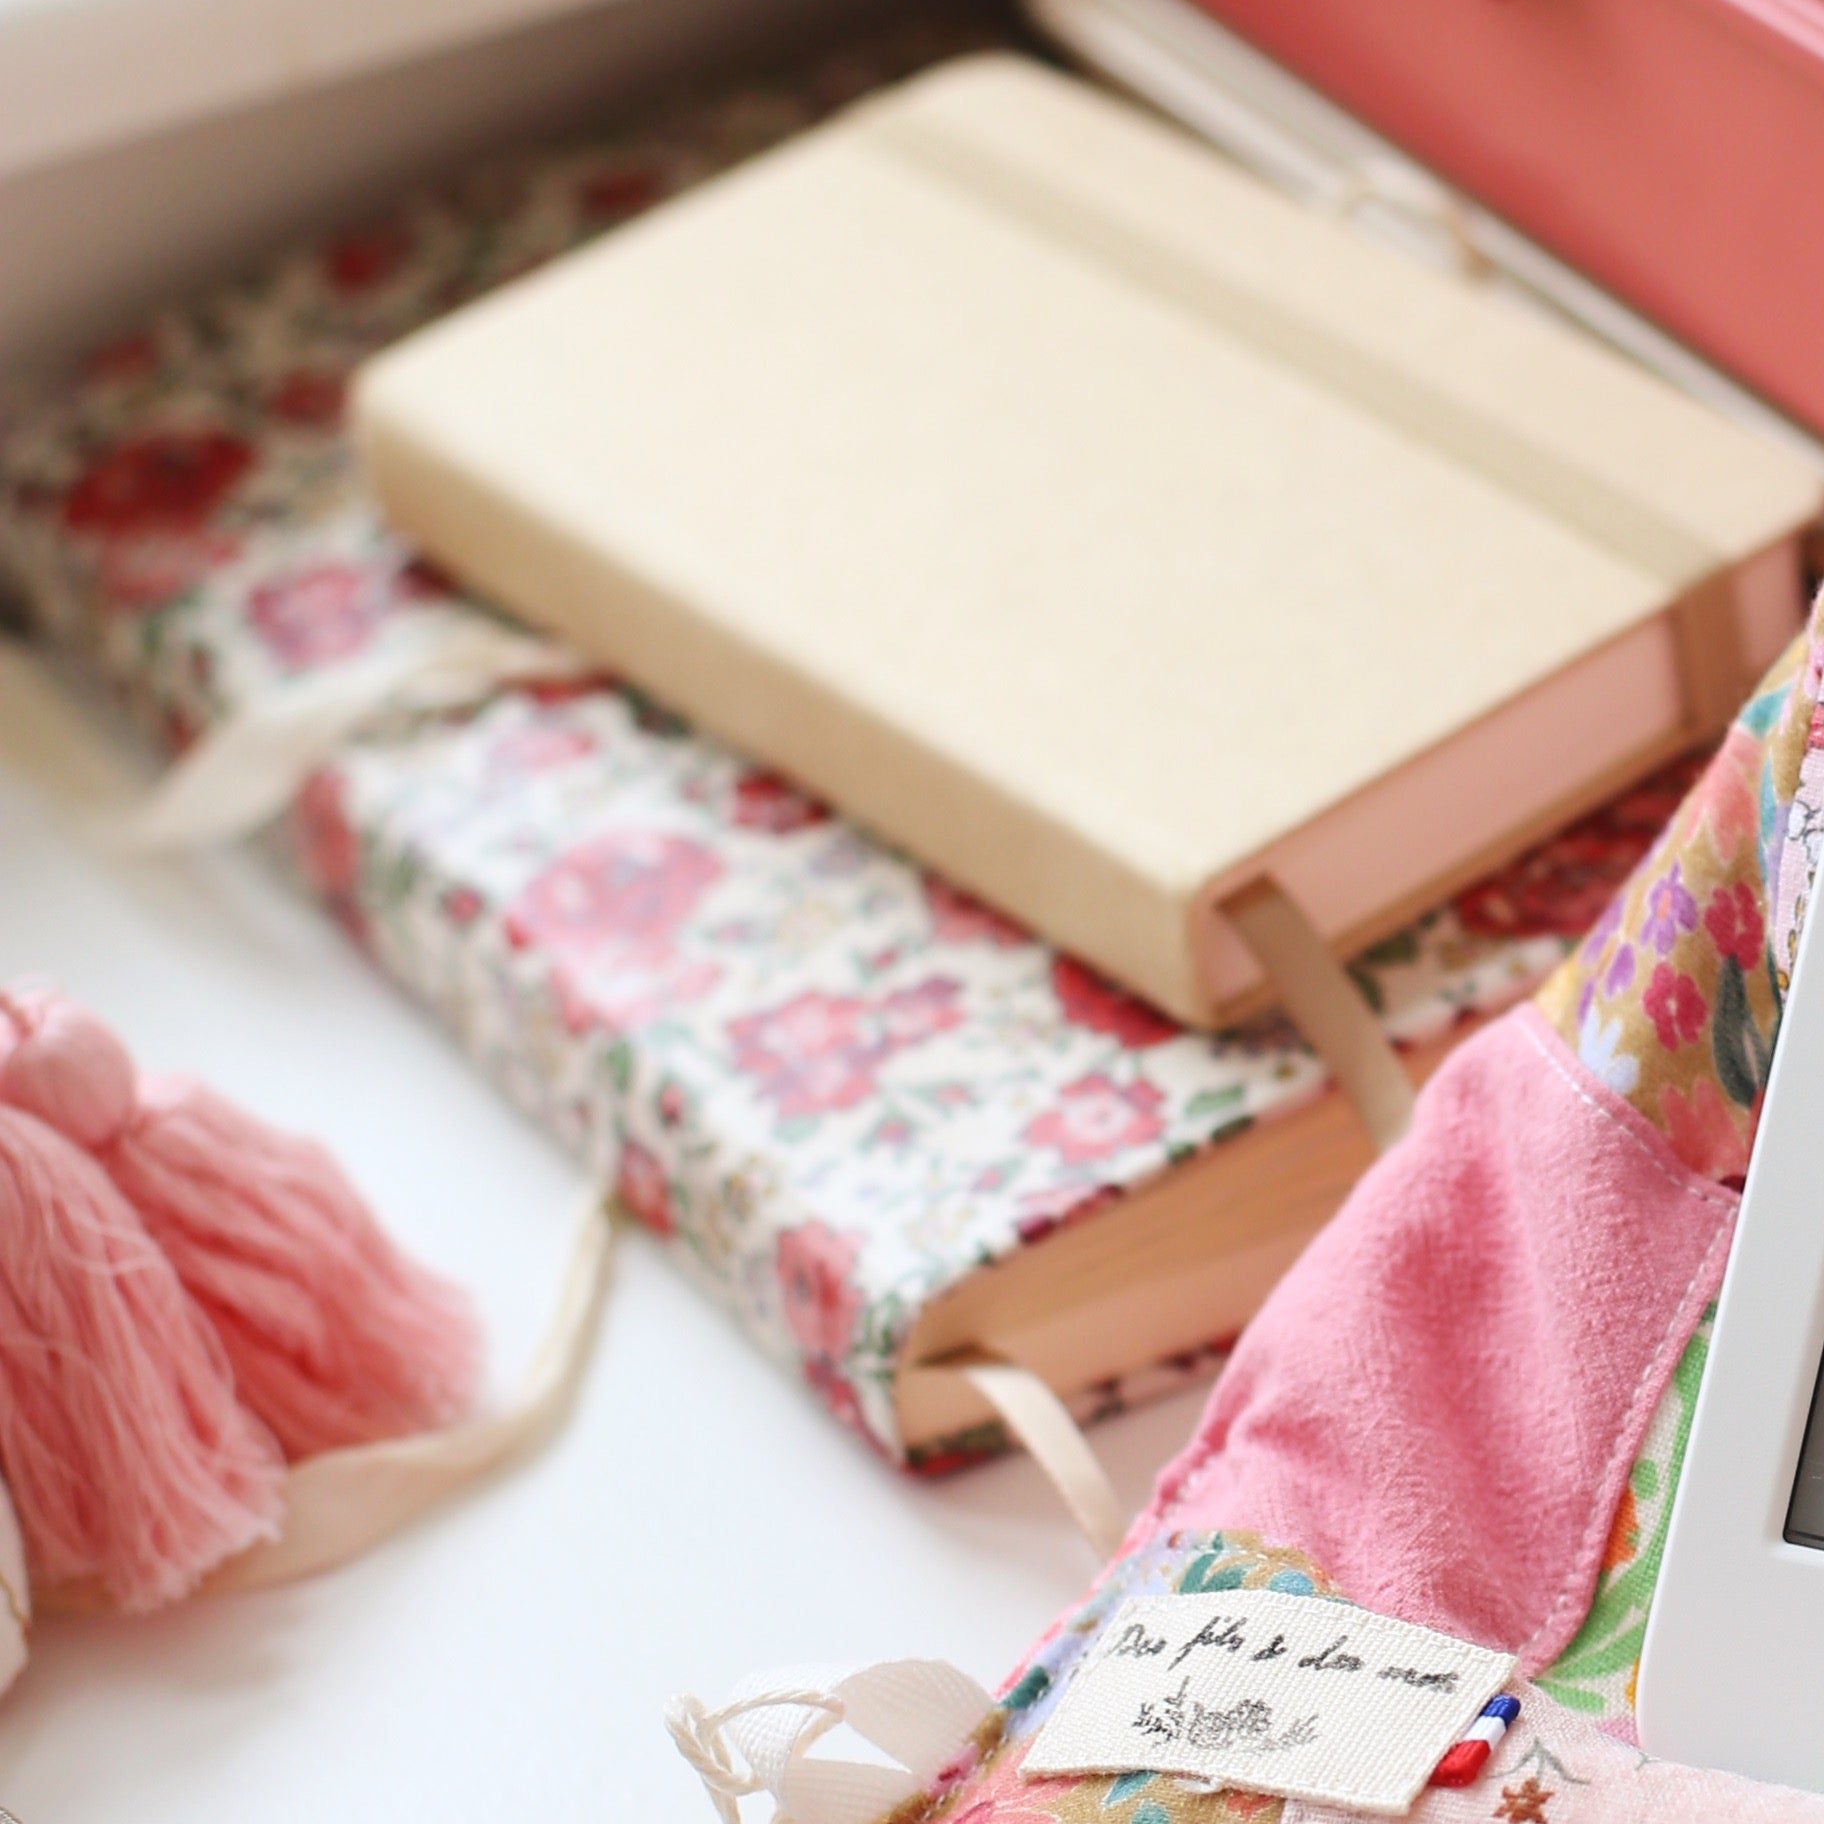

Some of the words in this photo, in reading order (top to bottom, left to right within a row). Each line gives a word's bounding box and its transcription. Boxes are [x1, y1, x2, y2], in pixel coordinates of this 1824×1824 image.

[1105, 1624, 1167, 1658] Des
[1168, 1616, 1250, 1671] fils
[1252, 1634, 1288, 1662] &
[1299, 1635, 1365, 1671] des
